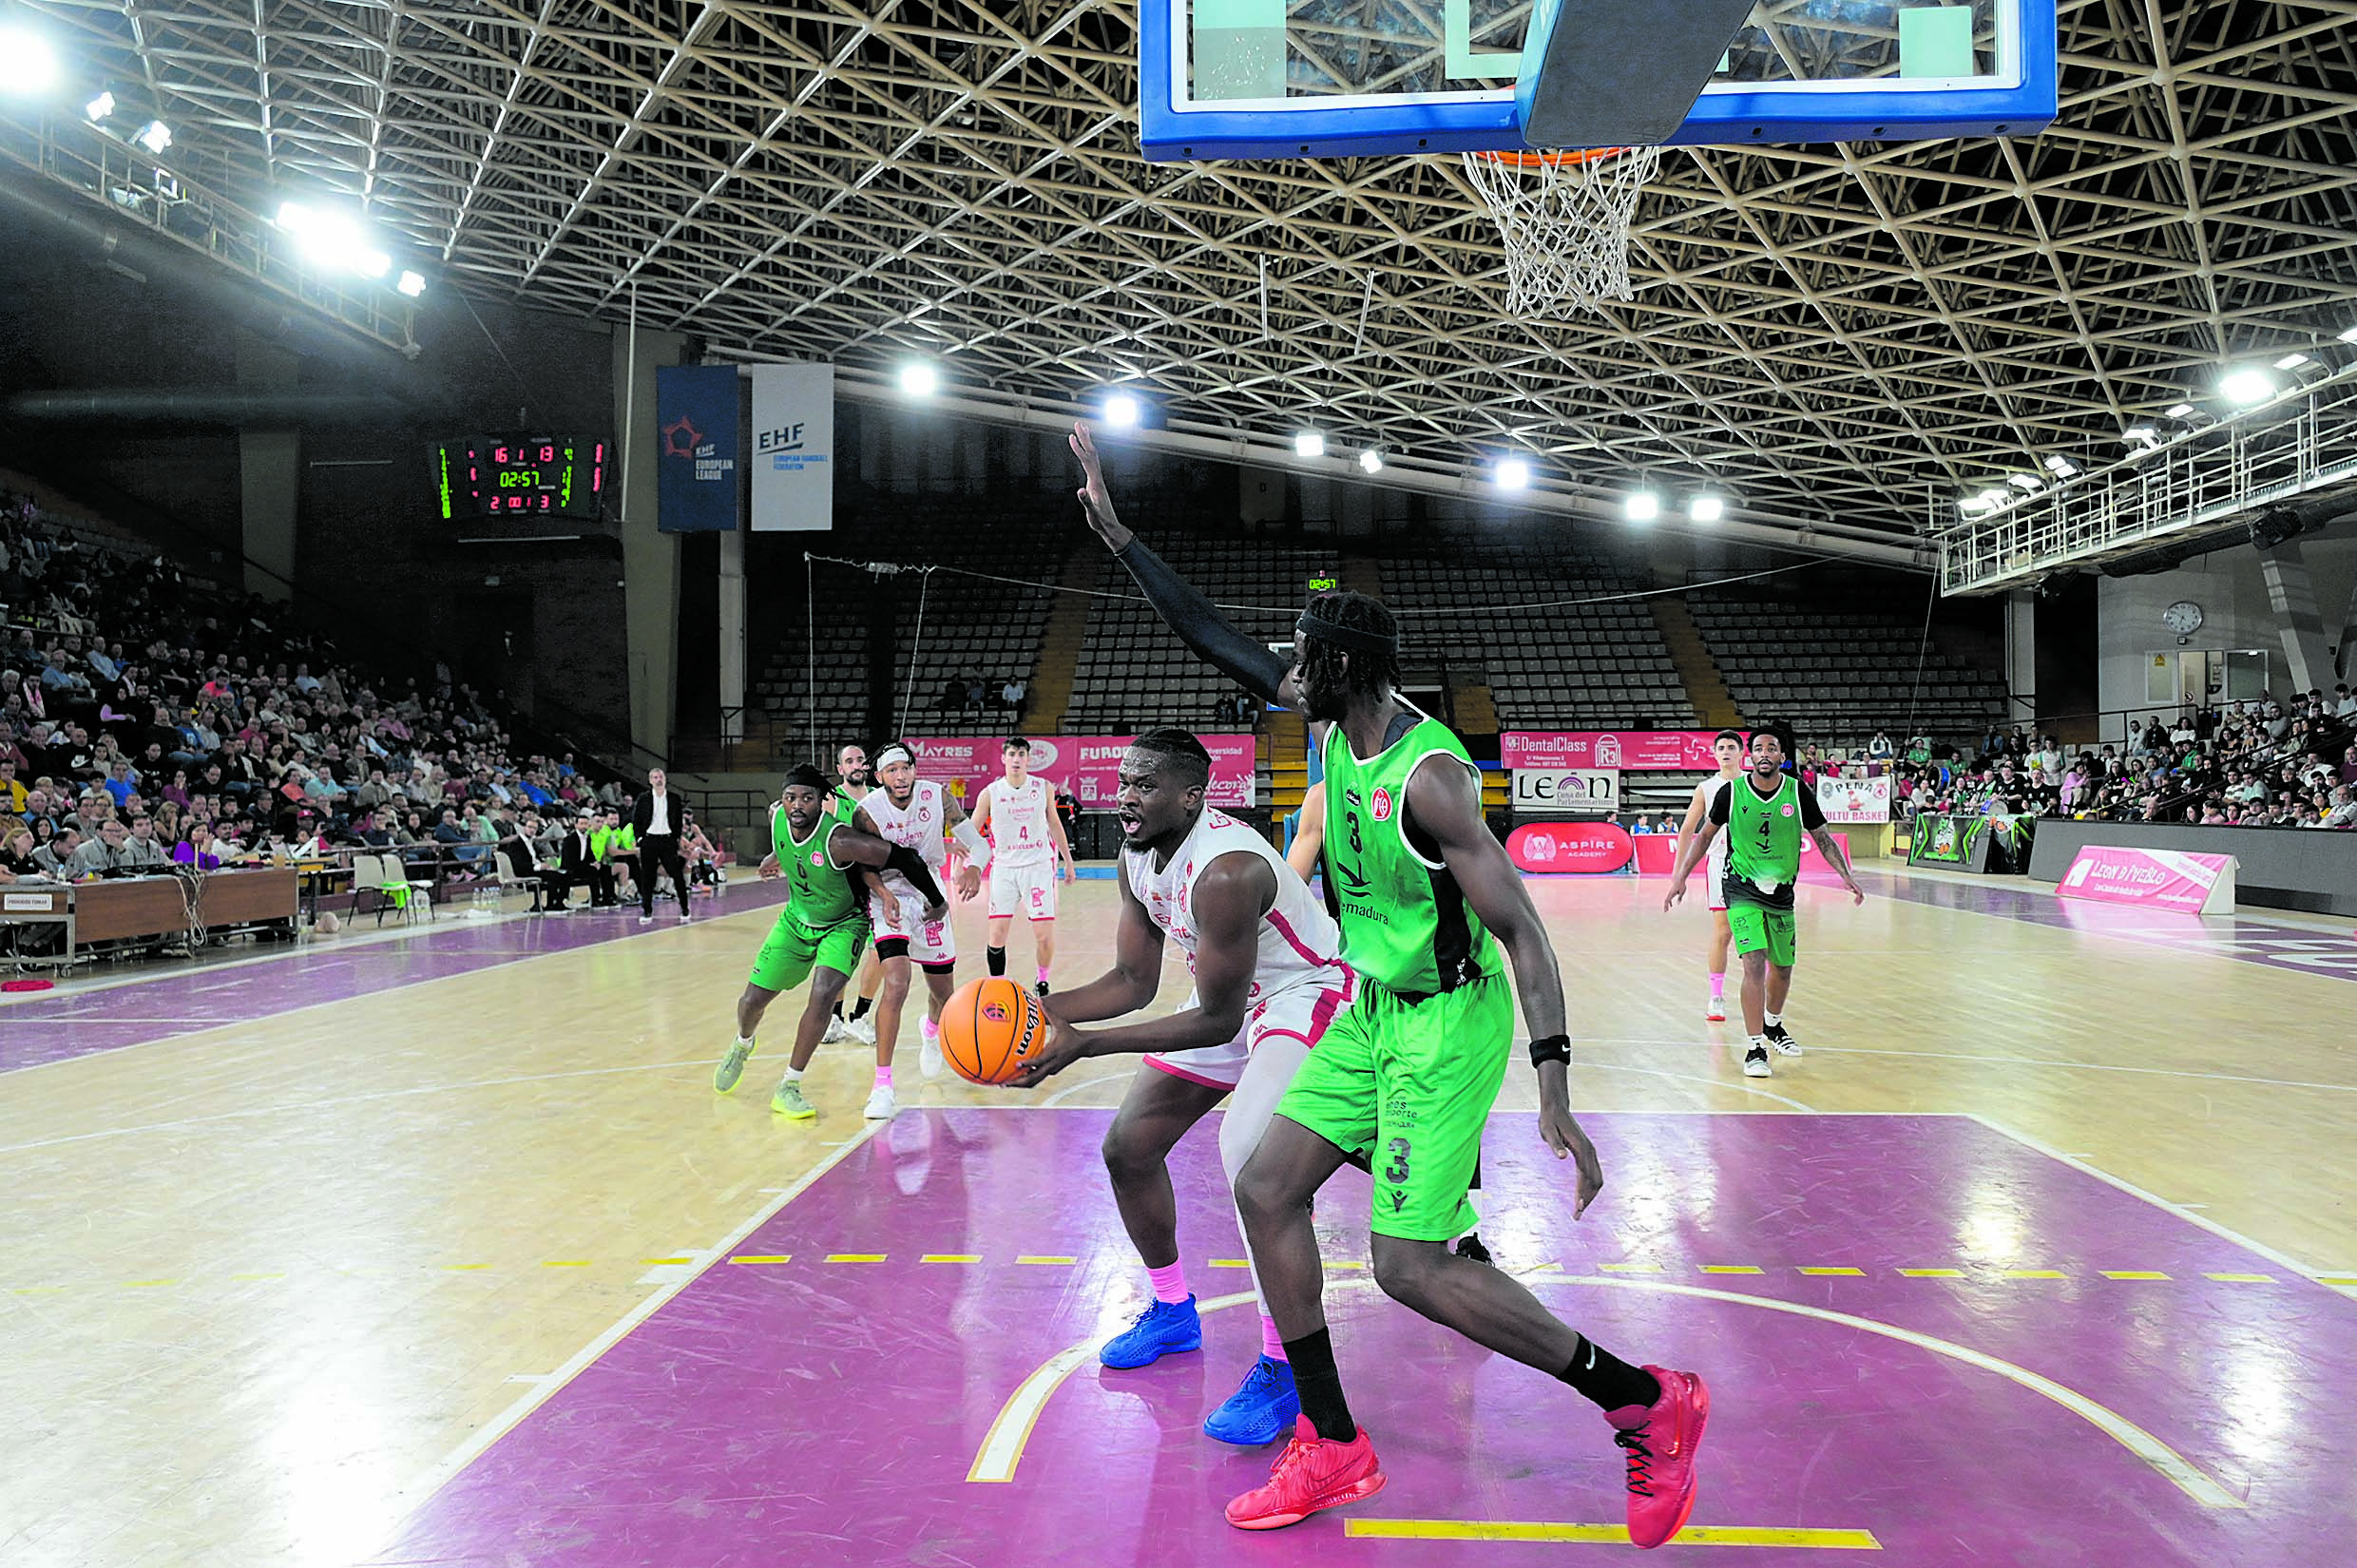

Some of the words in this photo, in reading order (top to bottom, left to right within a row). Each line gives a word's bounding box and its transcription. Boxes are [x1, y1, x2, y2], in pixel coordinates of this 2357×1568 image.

[758, 422, 805, 450] EHF
[494, 447, 508, 463] 16
[540, 446, 554, 462] 13
[695, 459, 734, 469] EUROPEAN
[500, 470, 540, 488] 02:57
[695, 469, 722, 481] LEAGUE
[490, 496, 500, 509] 2
[541, 495, 550, 508] 3
[1309, 579, 1336, 589] 02:57
[908, 740, 974, 757] MAYRES
[1522, 736, 1587, 752] DentalClass
[1600, 748, 1617, 764] R3
[1823, 811, 1849, 821] ULTU
[1852, 811, 1888, 821] BASKET
[1020, 825, 1028, 841] 4
[1345, 811, 1363, 854] 3
[1758, 820, 1771, 837] 4
[1016, 989, 1040, 1056] Wilson
[1386, 1137, 1412, 1184] 3
